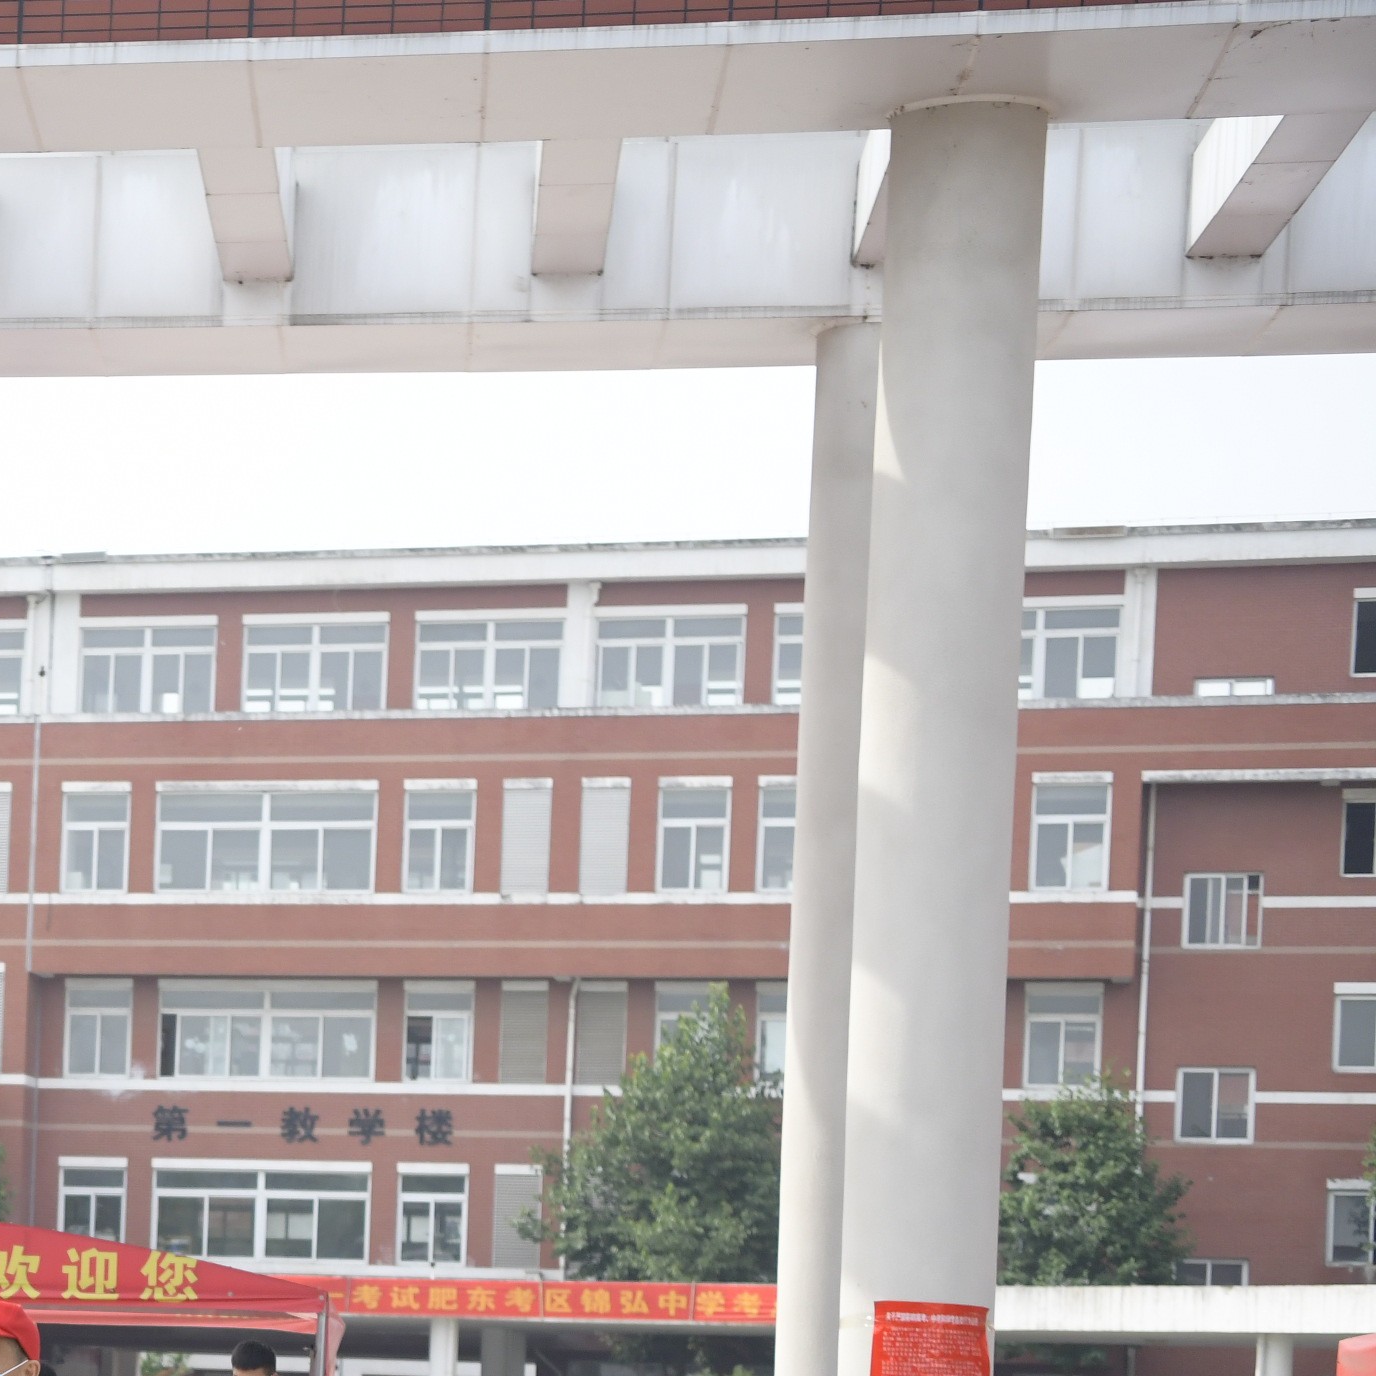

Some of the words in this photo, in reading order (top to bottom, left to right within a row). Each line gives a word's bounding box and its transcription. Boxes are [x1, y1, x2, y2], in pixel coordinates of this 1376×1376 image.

[152, 1105, 454, 1146] 第一教学楼
[328, 1284, 776, 1319] 一考试肥东考区锦弘中学考
